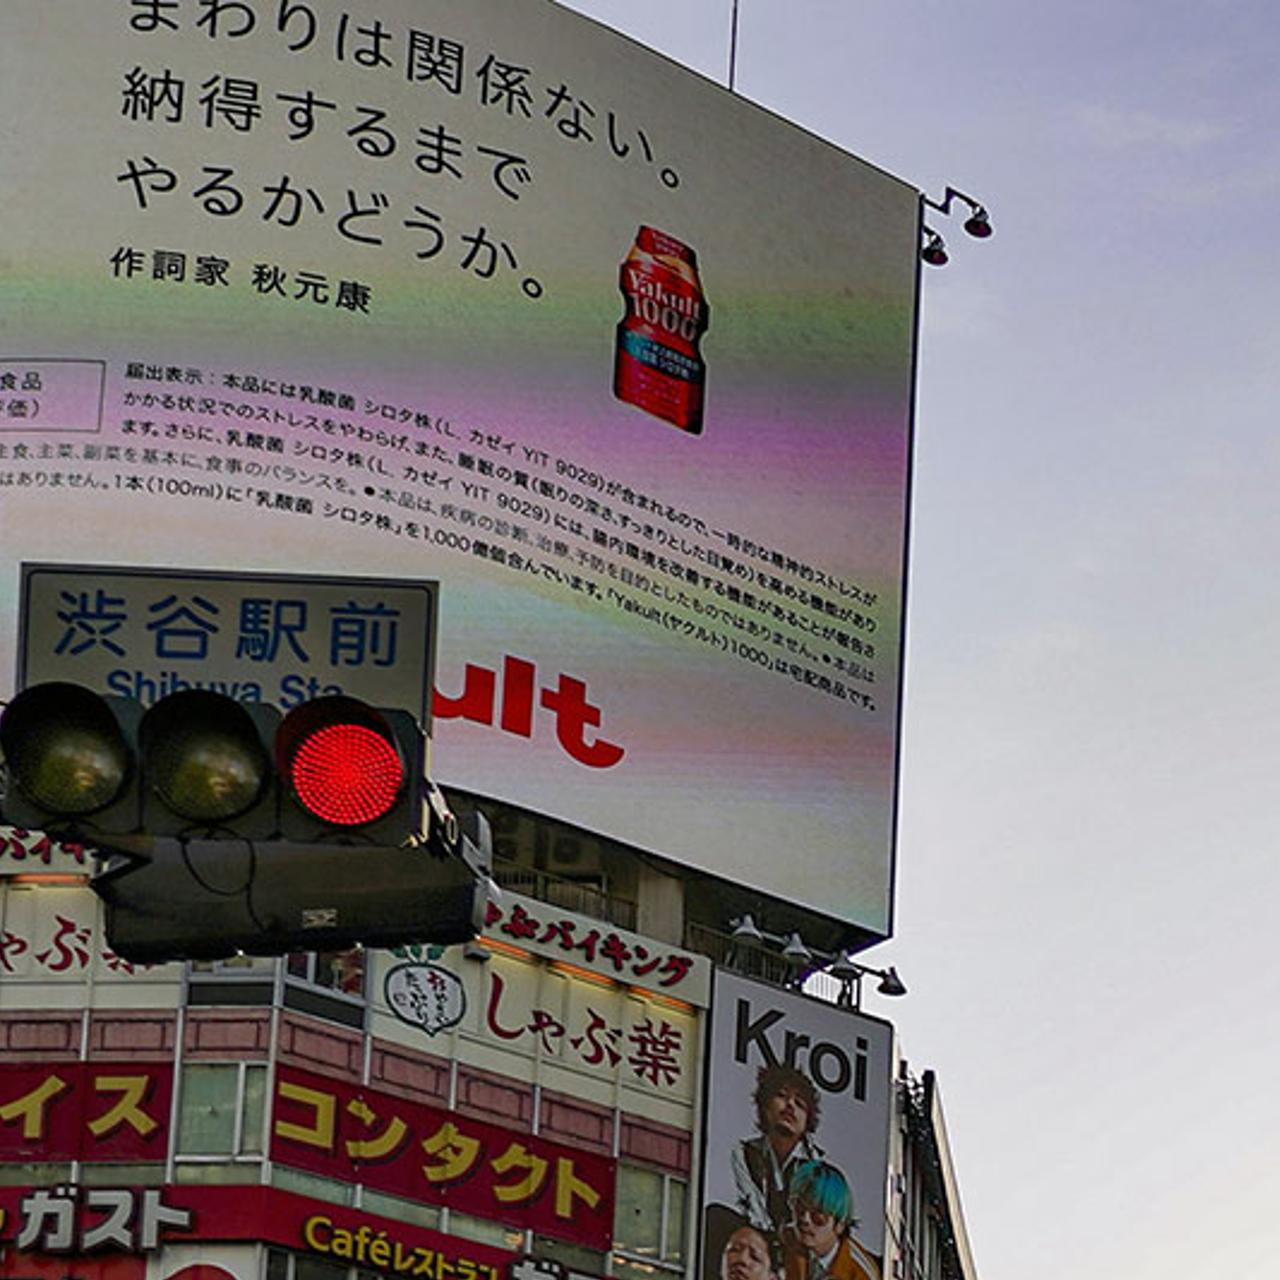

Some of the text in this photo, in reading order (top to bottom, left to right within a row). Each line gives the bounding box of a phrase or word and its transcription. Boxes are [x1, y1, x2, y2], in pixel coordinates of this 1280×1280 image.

[121, 66, 533, 202] 納得するまで
[116, 155, 545, 301] やるかどうか。
[110, 248, 374, 315] 作詞家 秋元康
[630, 291, 697, 342] 1000
[54, 589, 400, 668] 渋谷駅前
[487, 971, 682, 1087] しゃぶ葉
[734, 999, 869, 1102] Kroi
[275, 1081, 601, 1219] コンタクト
[18, 1182, 191, 1249] ガスト
